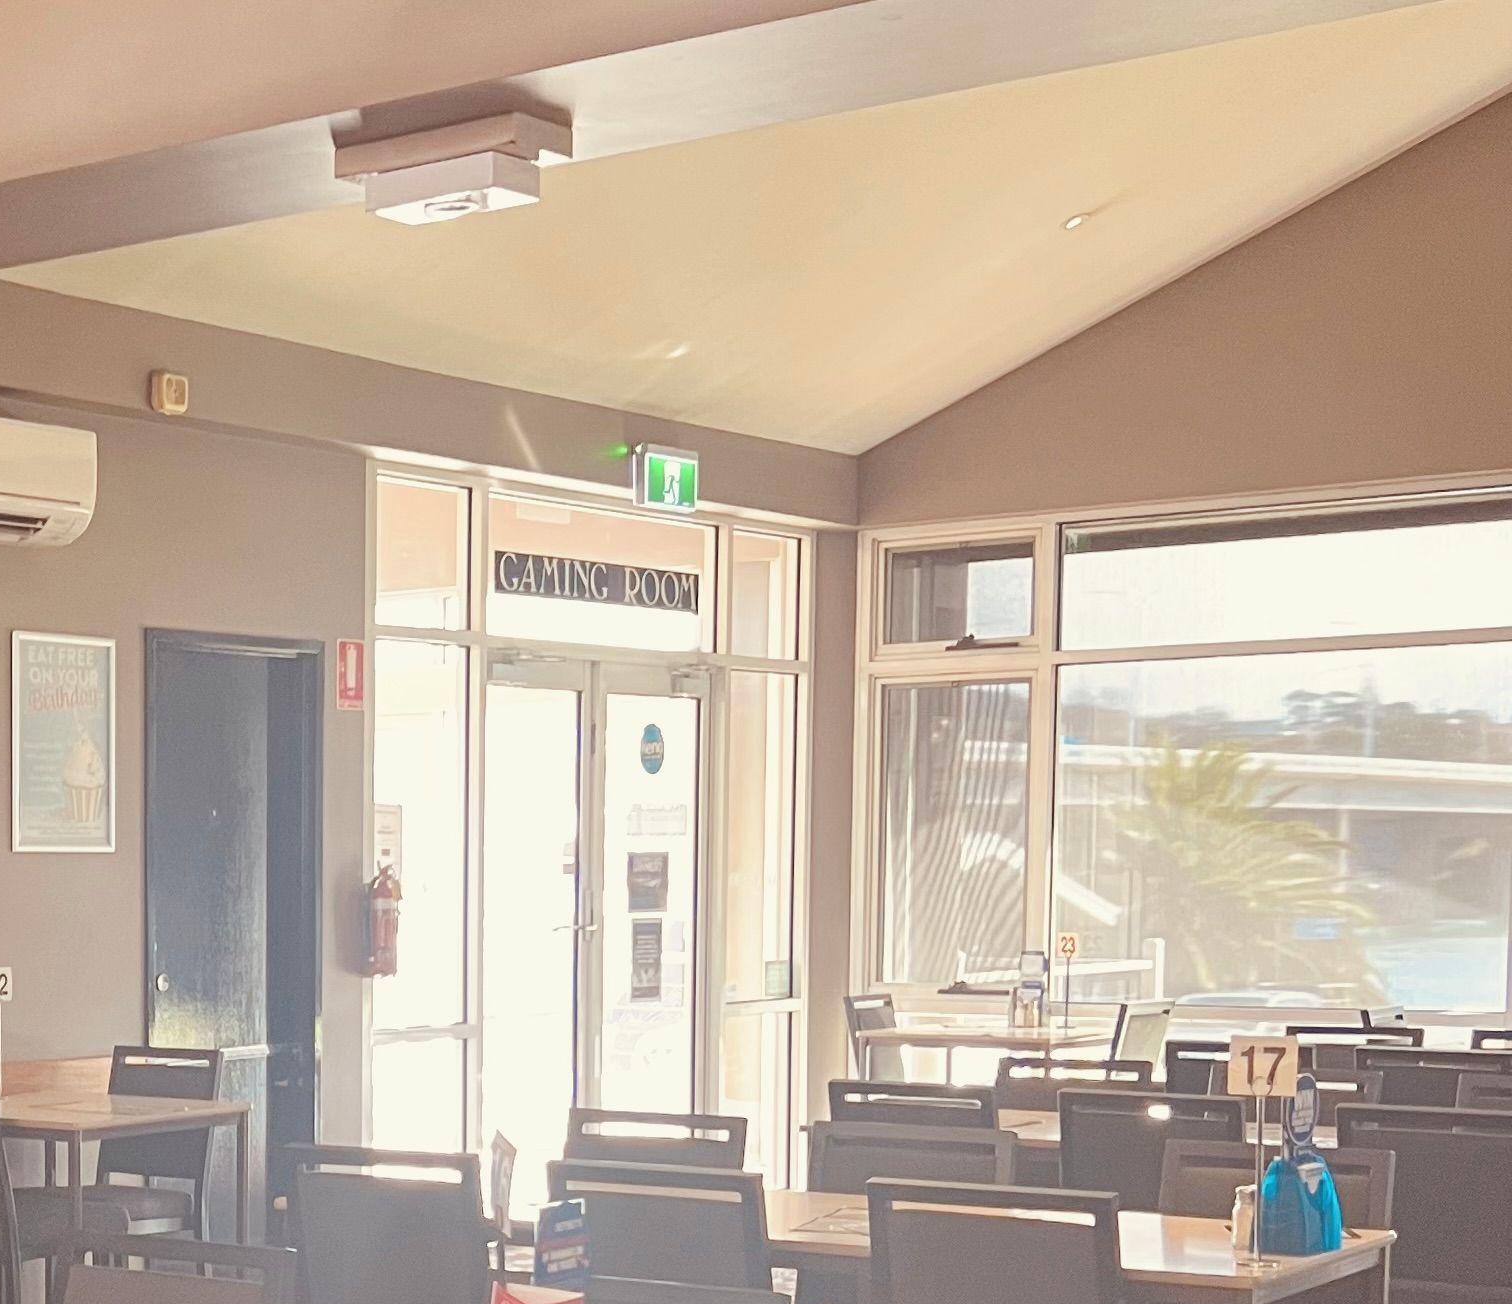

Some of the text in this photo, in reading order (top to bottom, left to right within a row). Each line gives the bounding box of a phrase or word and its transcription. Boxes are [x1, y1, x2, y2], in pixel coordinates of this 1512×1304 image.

[499, 553, 697, 610] GAMING ROOM
[29, 646, 95, 667] EAT FREE
[30, 667, 98, 688] ON YOUR
[1061, 936, 1076, 954] 23
[1241, 1046, 1286, 1085] 17
